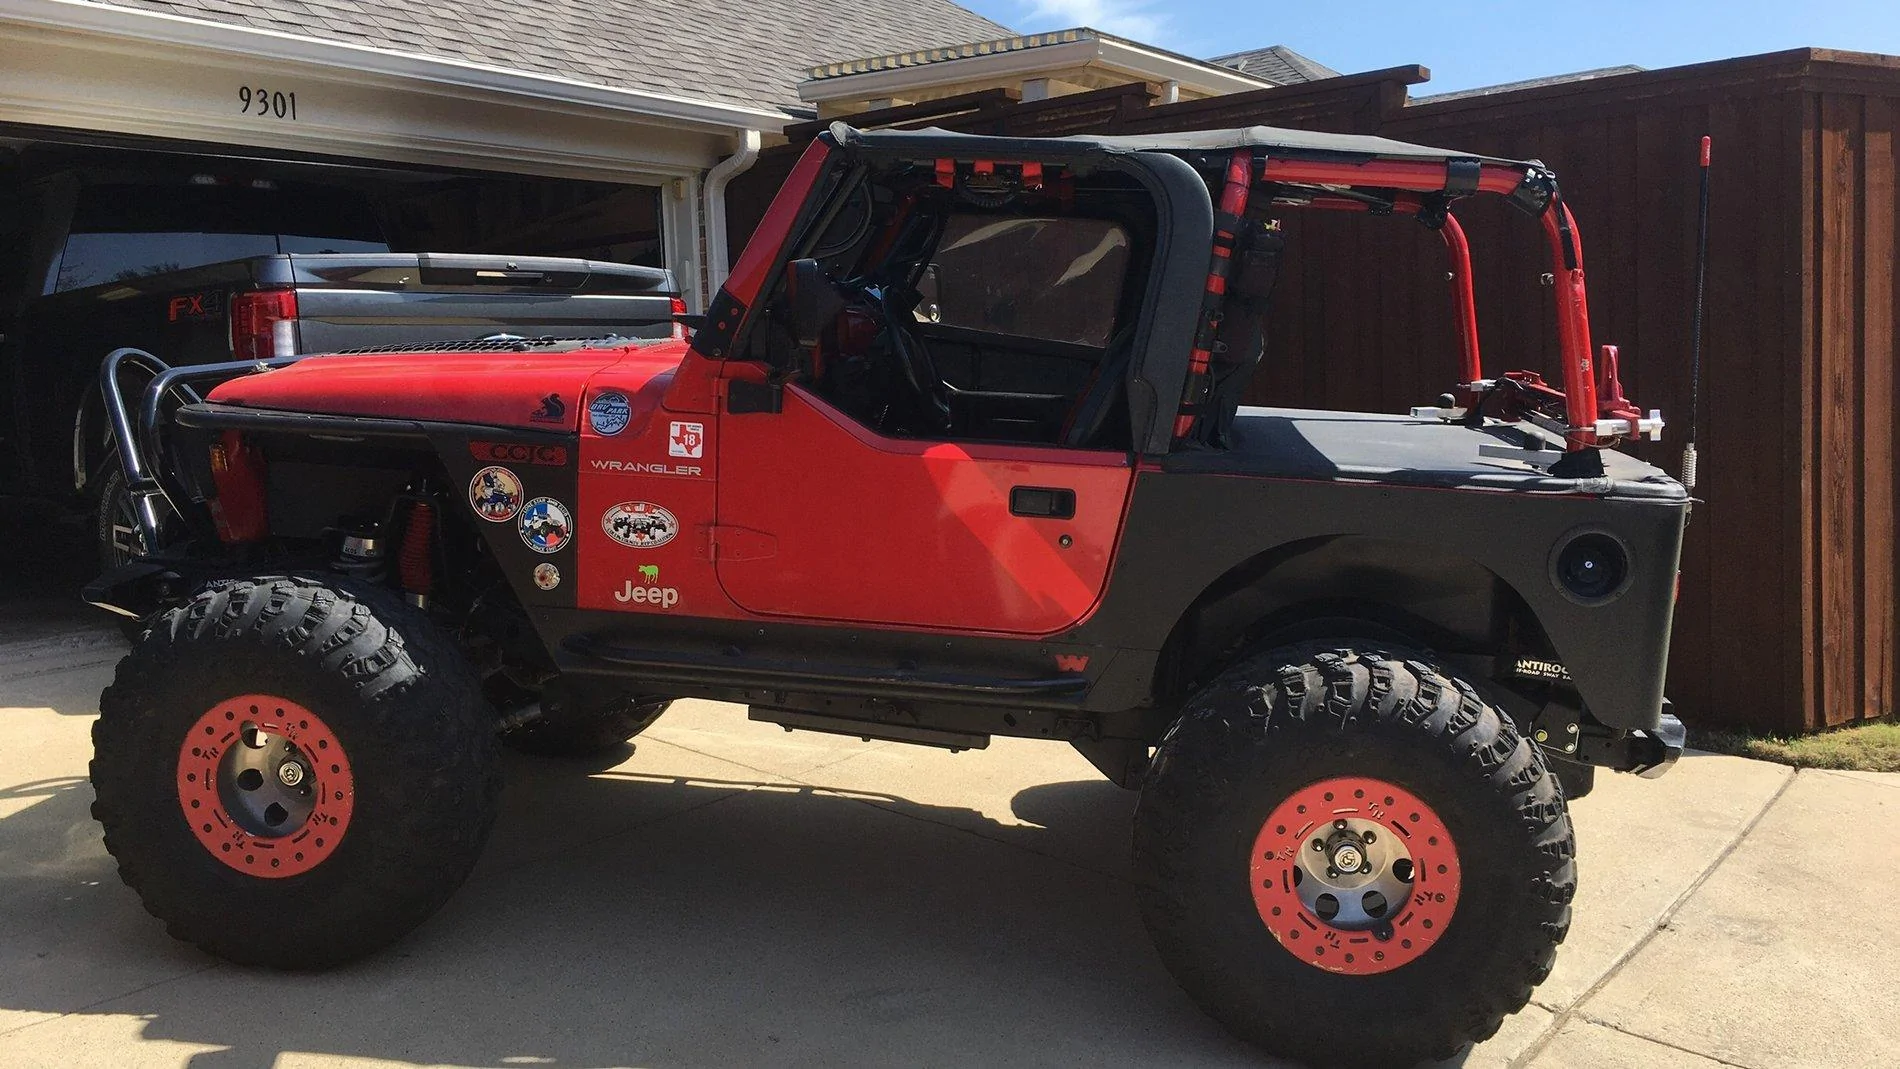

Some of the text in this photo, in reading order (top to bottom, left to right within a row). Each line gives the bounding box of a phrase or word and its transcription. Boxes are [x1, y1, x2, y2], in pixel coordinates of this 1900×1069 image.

[238, 86, 298, 121] 9301
[606, 407, 629, 415] PARK
[683, 434, 696, 447] 18
[590, 460, 702, 476] WRANGLER
[614, 580, 679, 608] Jeep
[1514, 660, 1568, 674] ANTIROC
